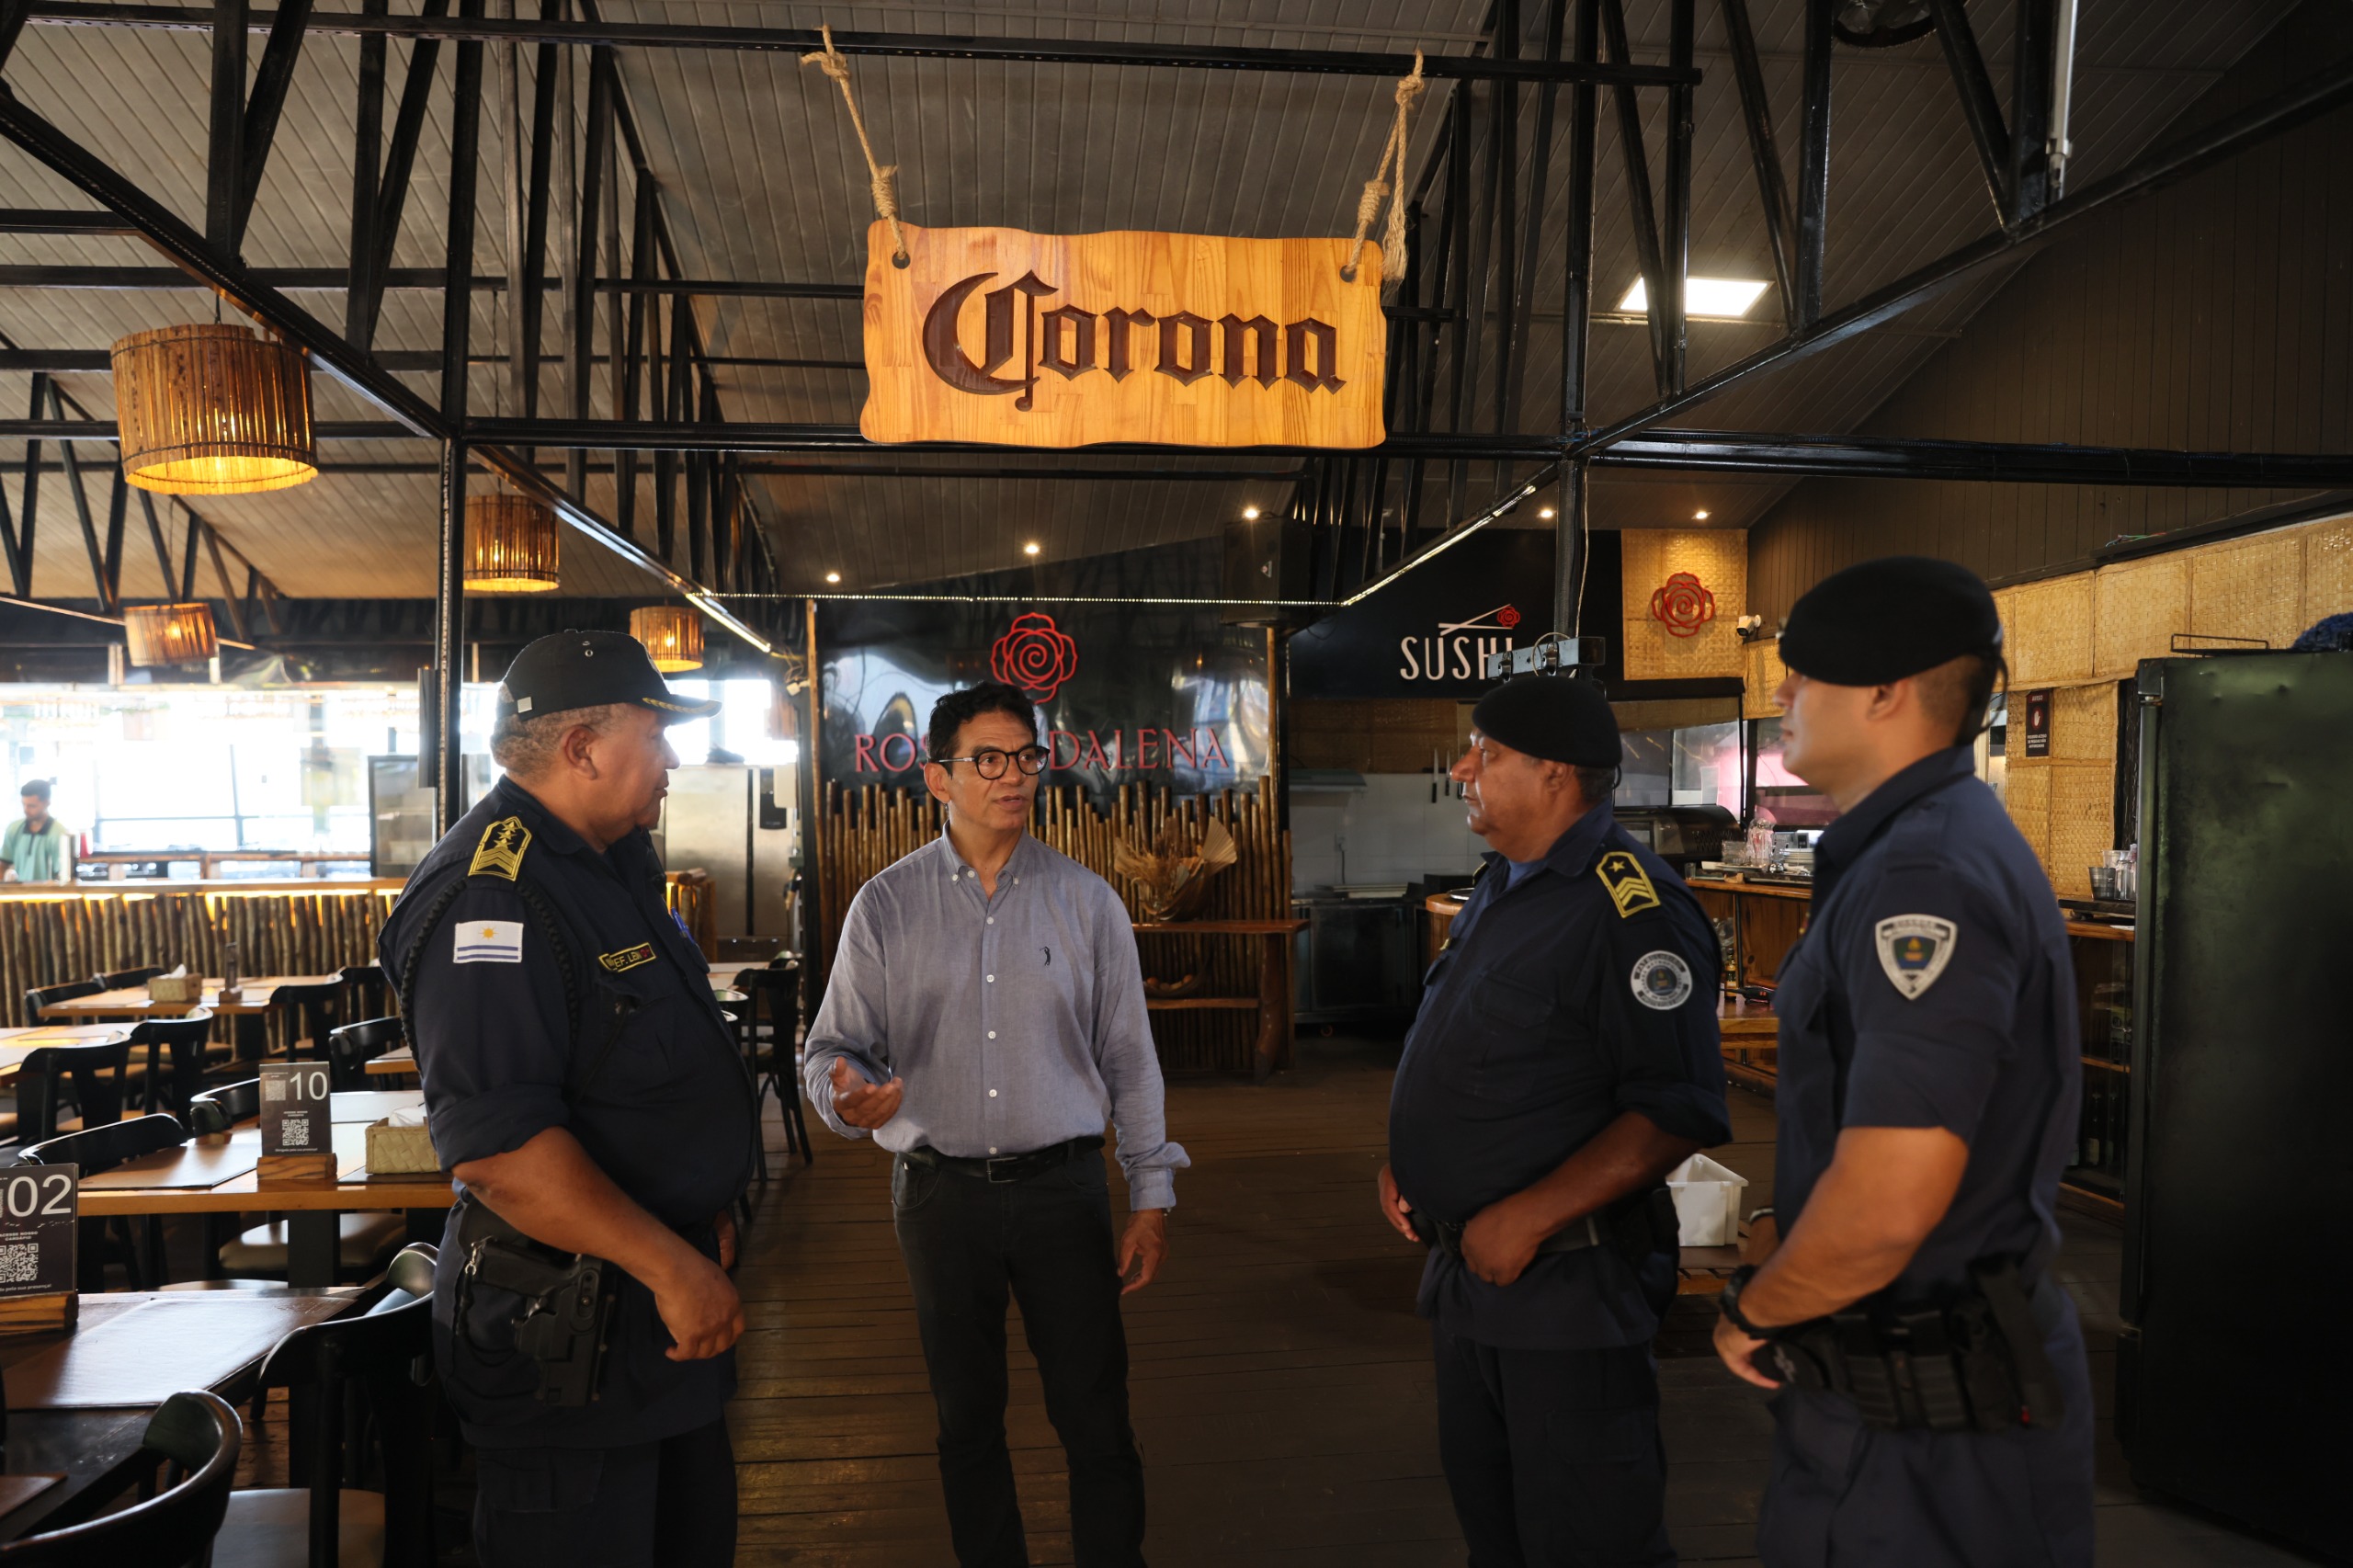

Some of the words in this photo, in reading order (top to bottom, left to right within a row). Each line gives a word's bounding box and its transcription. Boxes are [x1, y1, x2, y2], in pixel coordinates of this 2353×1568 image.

[922, 268, 1347, 412] Corona
[1049, 727, 1230, 771] DALENA
[290, 1072, 328, 1101] 10
[7, 1174, 72, 1218] 02
